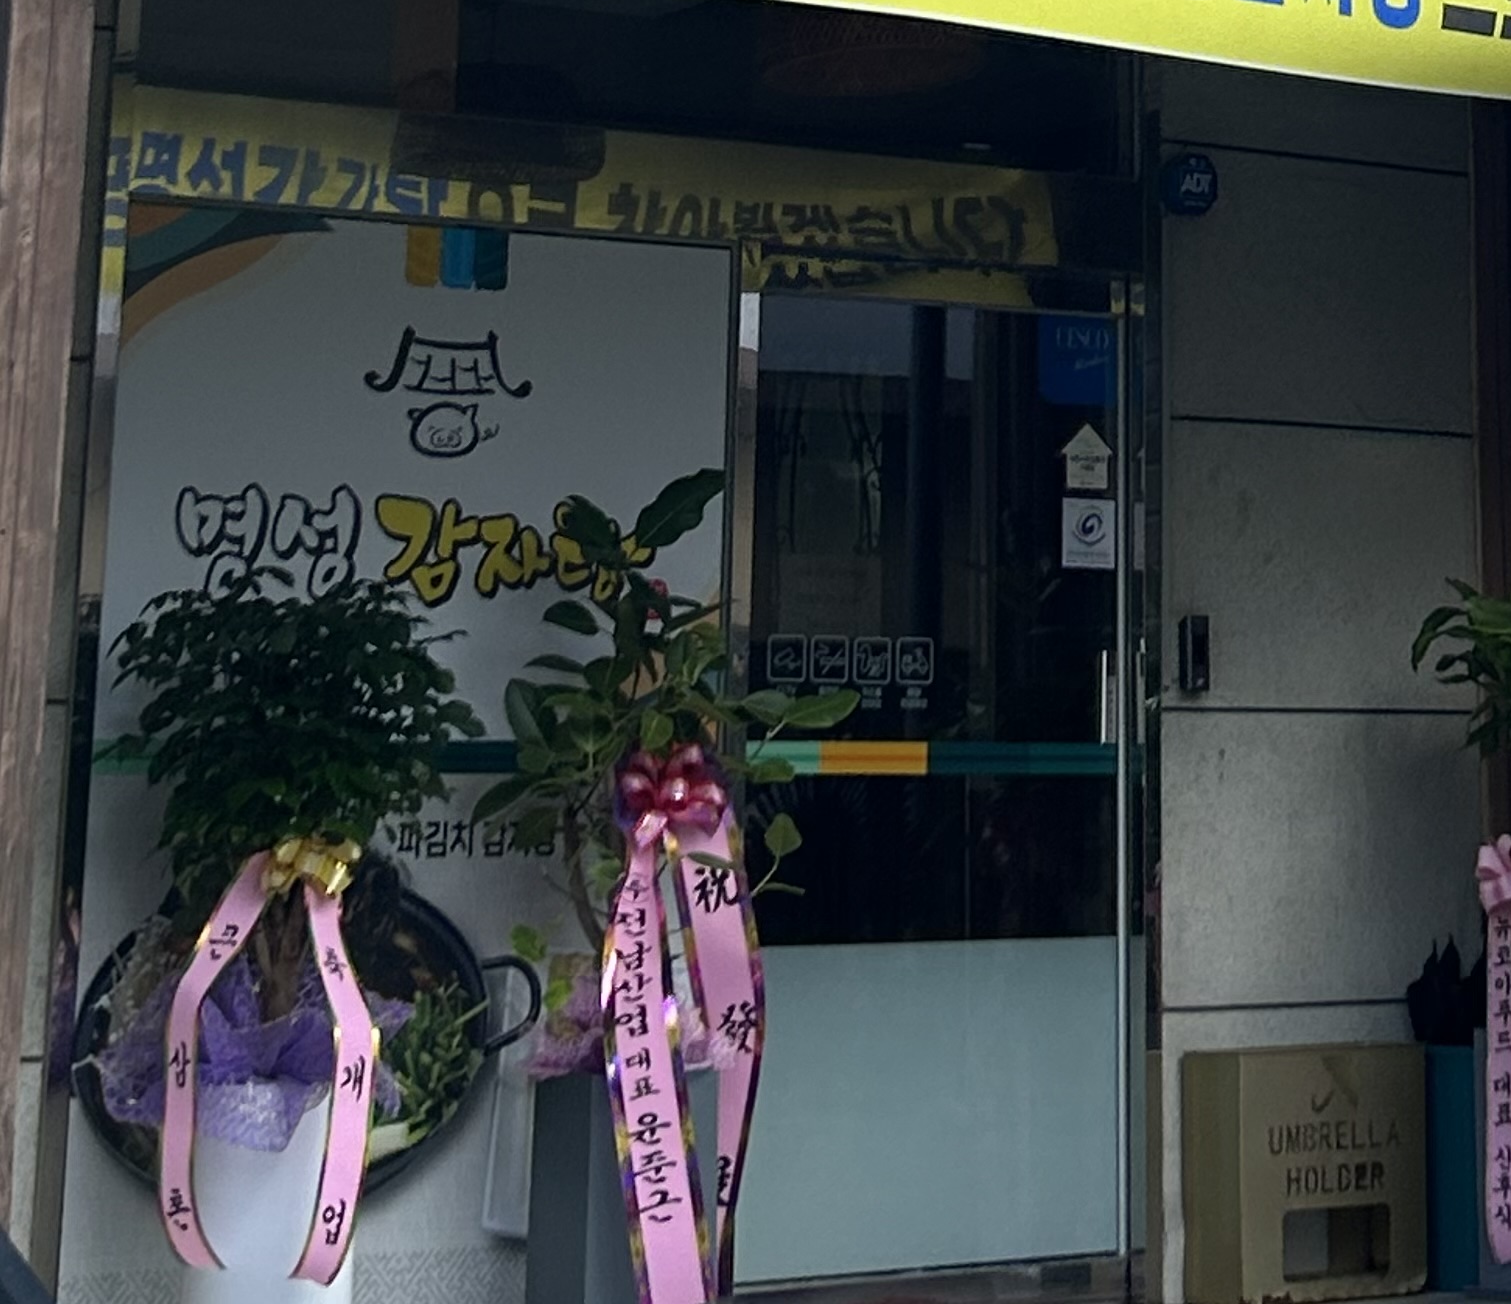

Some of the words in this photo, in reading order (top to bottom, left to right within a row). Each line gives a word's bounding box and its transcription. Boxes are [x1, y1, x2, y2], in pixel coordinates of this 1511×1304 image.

[1181, 172, 1213, 195] ADT
[176, 483, 362, 602] 명성
[624, 1048, 662, 1101] 대표
[1268, 1119, 1402, 1156] UMBRELLA
[1286, 1161, 1385, 1197] HOLDER
